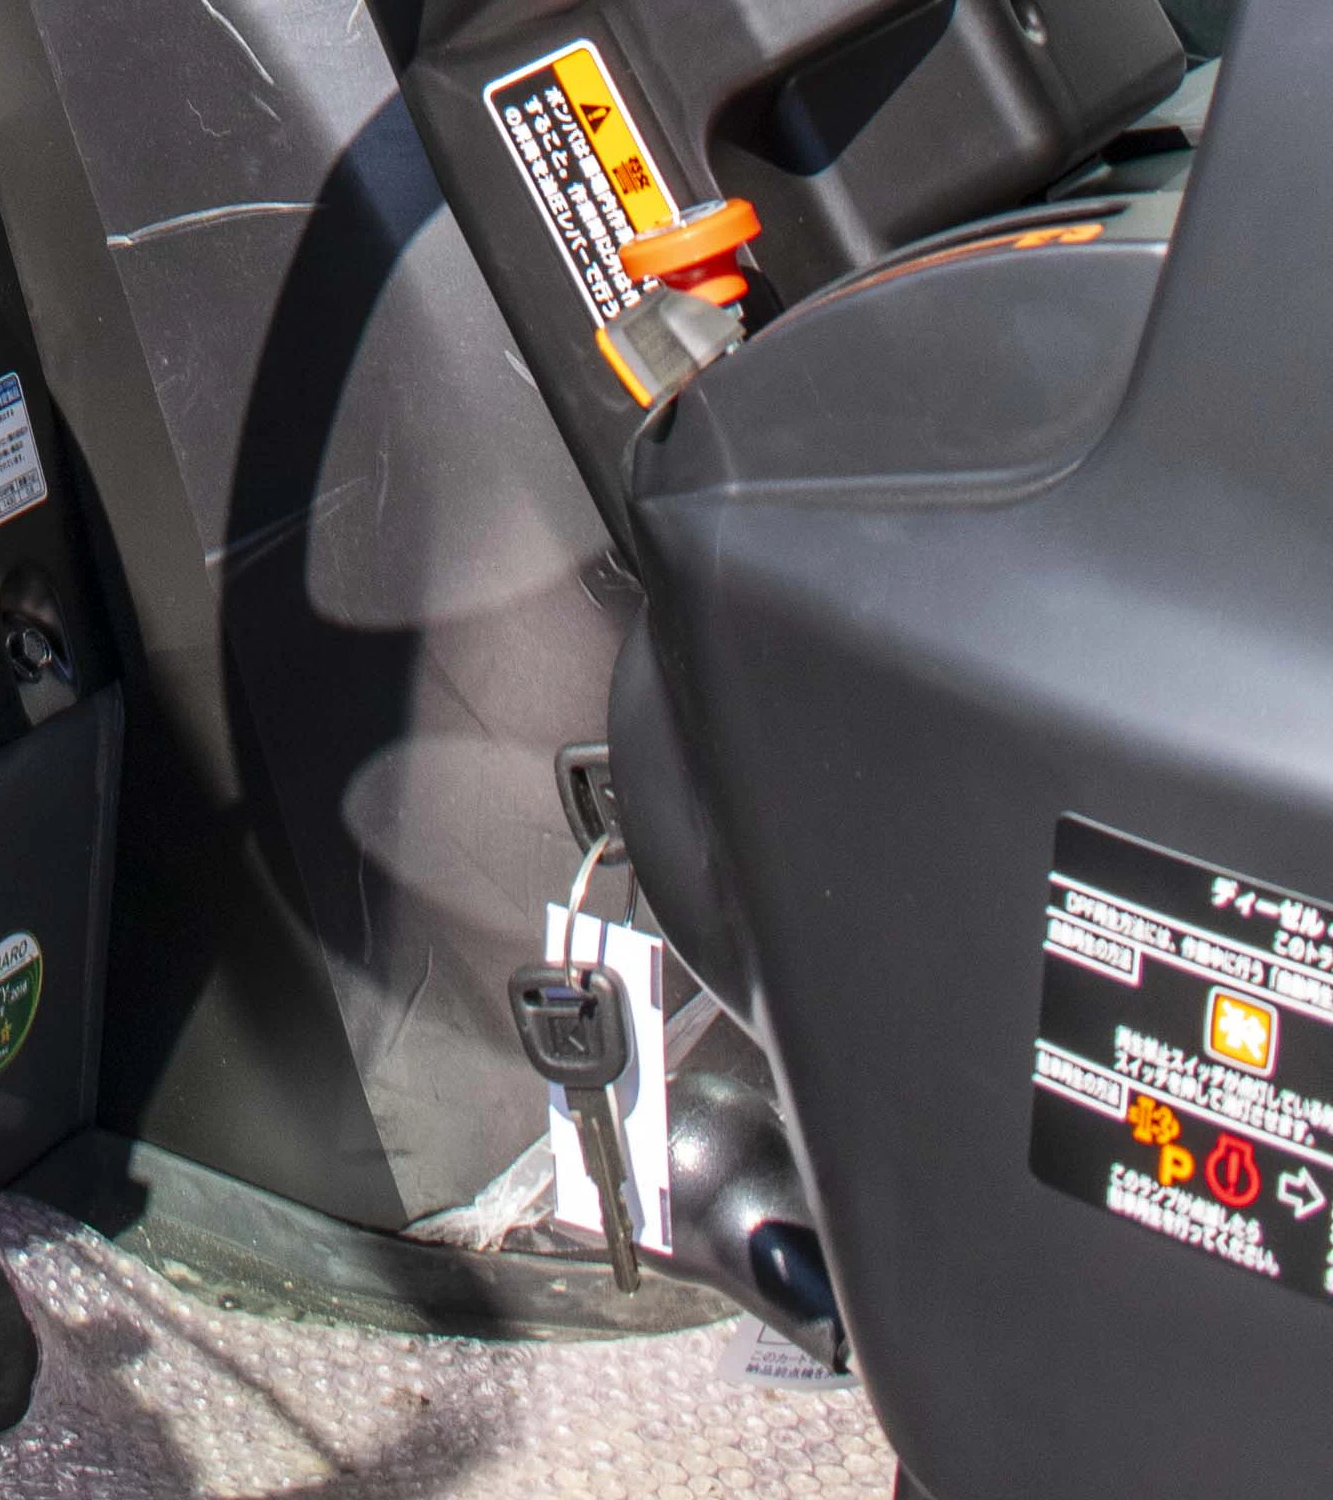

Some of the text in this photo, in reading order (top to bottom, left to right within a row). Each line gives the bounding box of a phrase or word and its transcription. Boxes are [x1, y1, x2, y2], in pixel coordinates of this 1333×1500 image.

[1211, 872, 1333, 948] ディーゼル
